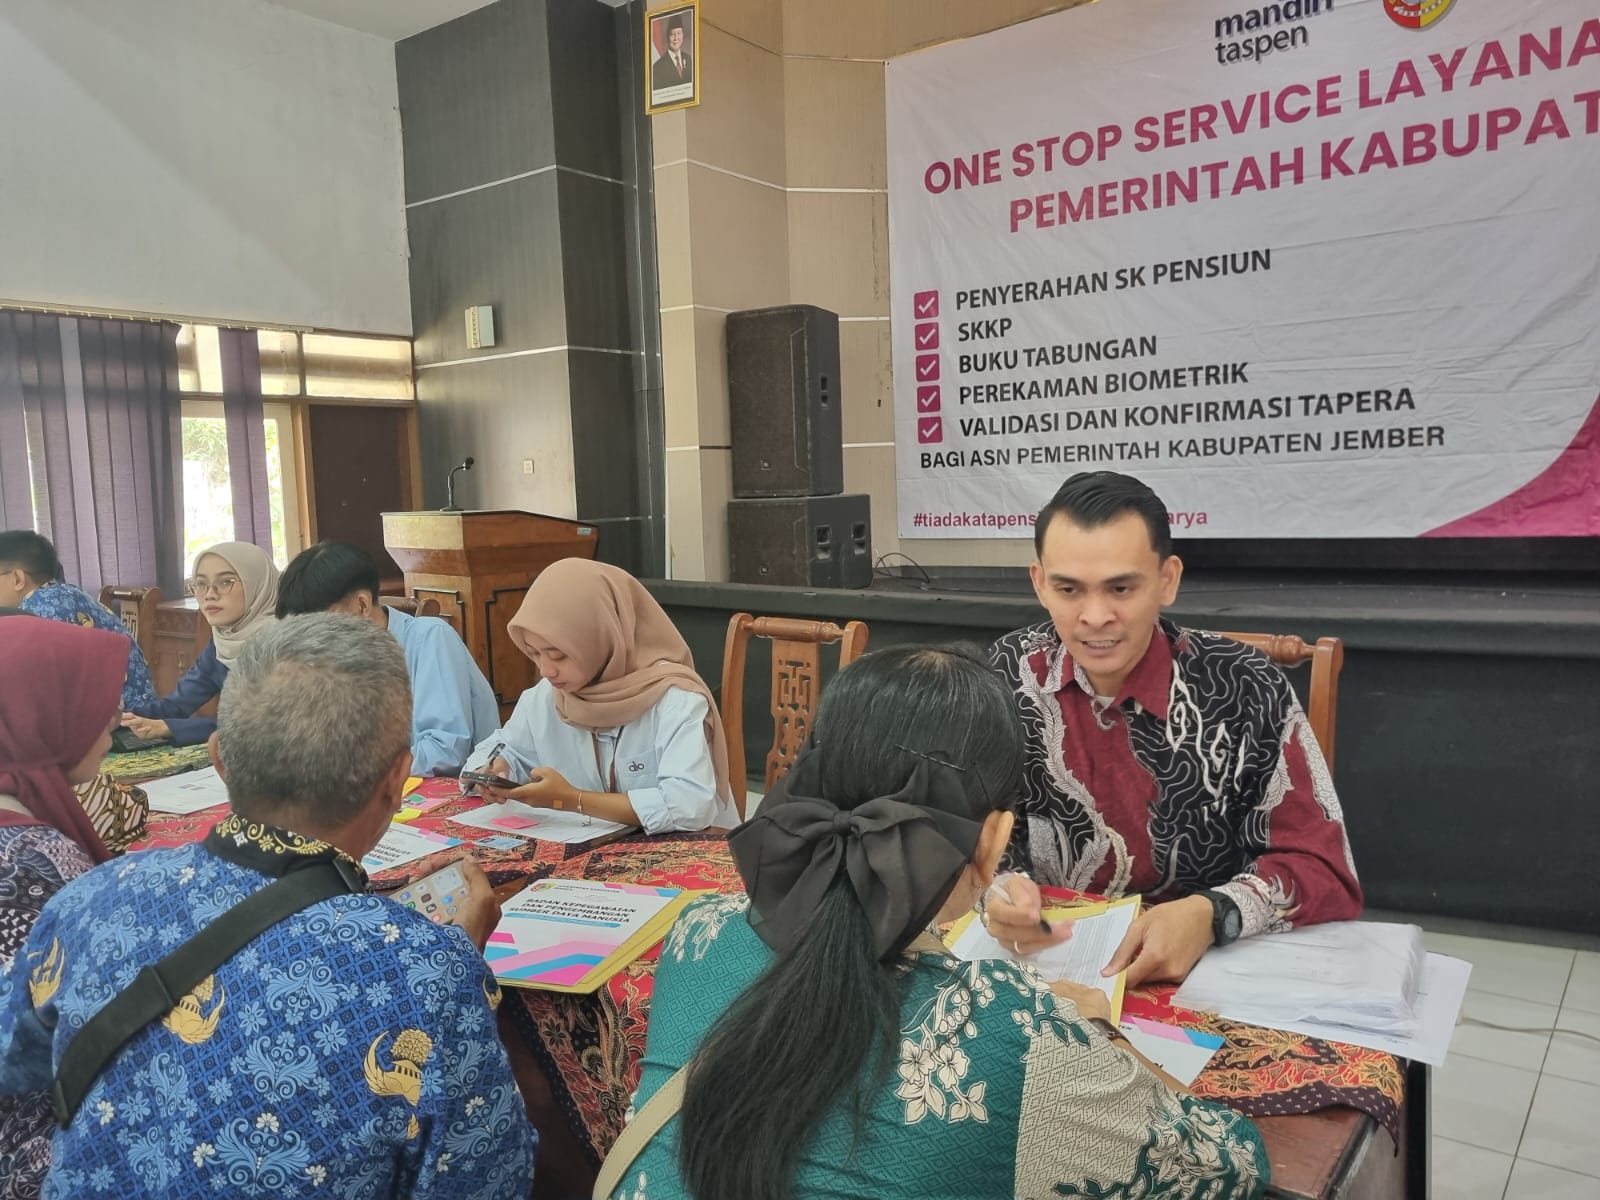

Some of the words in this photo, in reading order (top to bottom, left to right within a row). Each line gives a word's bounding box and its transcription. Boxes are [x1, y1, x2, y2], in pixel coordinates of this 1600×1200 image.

[1215, 26, 1308, 63] taspen
[924, 149, 1001, 195] ONE
[1012, 125, 1122, 178] STOP
[1134, 75, 1342, 154] SERVICE
[1358, 18, 1600, 108] LAYANA
[1010, 147, 1304, 232] PEMERINTAH
[1320, 90, 1600, 180] KABUPAT
[956, 271, 1109, 311] PENYERAHAN
[1114, 266, 1146, 290] SK
[1153, 248, 1271, 285] PENSIUN
[958, 317, 1013, 342] SKKP
[959, 350, 1018, 374] BUKU
[1023, 335, 1158, 367] TABUNGAN
[959, 373, 1099, 405] PEREKAMAN
[1105, 362, 1249, 395] BIOMETRIK
[960, 412, 1060, 437] VALIDASI
[1067, 407, 1118, 431] DAN
[1124, 396, 1292, 429] KONFIRMASI
[1297, 387, 1416, 416] TAPERA
[920, 449, 966, 469] BAGI
[970, 448, 1011, 466] ASN
[1016, 440, 1161, 466] PEMERINTAH
[1167, 430, 1323, 460] KABUPATEN
[1329, 425, 1446, 452] JEMBER
